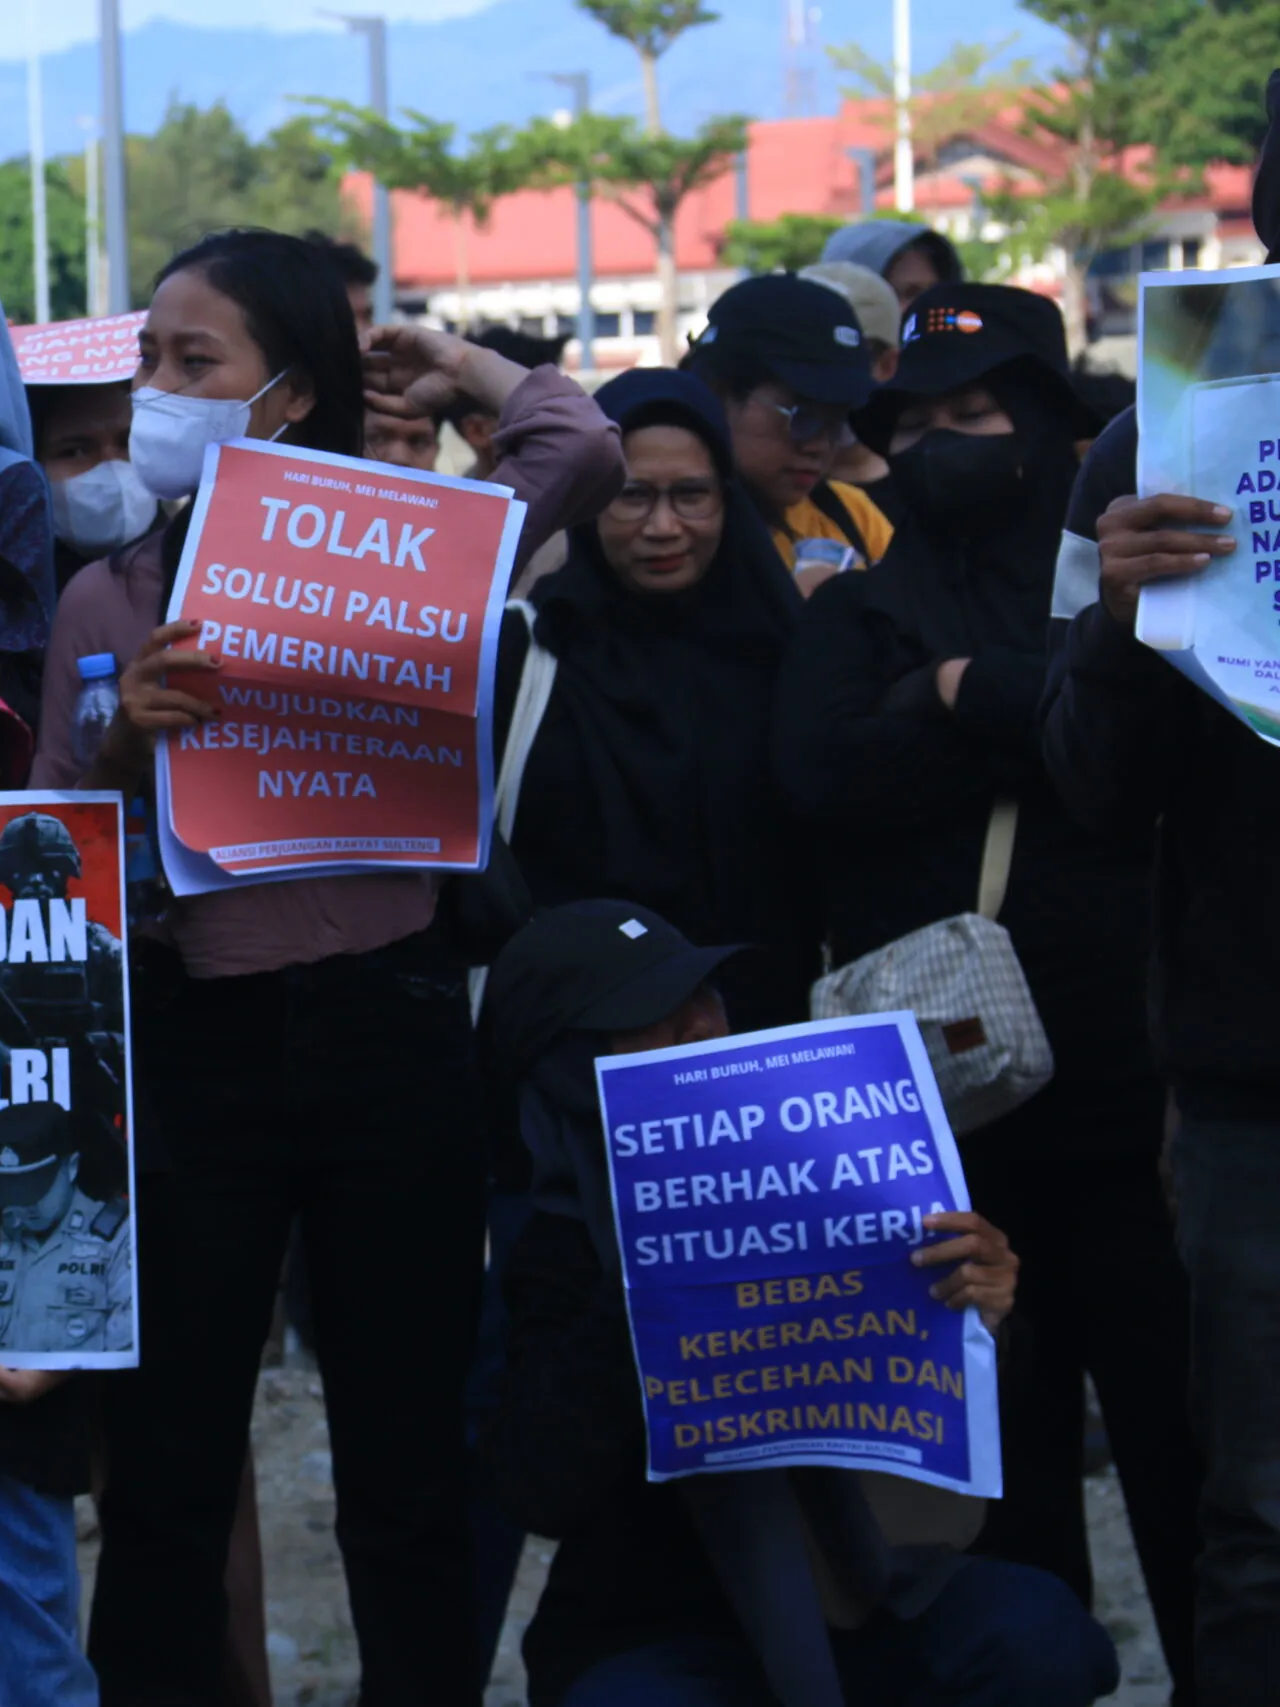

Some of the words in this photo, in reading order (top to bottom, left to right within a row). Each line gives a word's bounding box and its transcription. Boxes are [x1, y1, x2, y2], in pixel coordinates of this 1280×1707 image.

[283, 471, 310, 484] HARI
[311, 475, 352, 494] BURUH,
[355, 484, 377, 497] MEI
[377, 488, 439, 509] MELAWAN!
[260, 496, 437, 572] TOLAK
[201, 563, 335, 617] SOLUSI
[344, 590, 468, 643] PALSU
[198, 620, 452, 693] PEMERINTAH
[219, 685, 419, 727] WUJUDKAN
[179, 722, 463, 768] KESEJAHTERAAN
[258, 770, 377, 799] NYATA
[673, 1071, 708, 1086] HARI
[711, 1060, 764, 1079] BURUH,
[765, 1055, 791, 1069] MEI
[792, 1043, 856, 1064] MELAWAN!
[614, 1104, 765, 1158] SETIAP
[780, 1078, 922, 1133] ORANG
[633, 1158, 819, 1213] BERHAK
[830, 1140, 934, 1191] ATAS
[635, 1221, 808, 1266] SITUASI
[736, 1271, 864, 1309] BEBAS
[679, 1308, 929, 1361] KEKERASAN,
[645, 1357, 873, 1407] PELECEHAN
[887, 1355, 964, 1399] DAN
[674, 1404, 944, 1449] DISKRIMINASI
